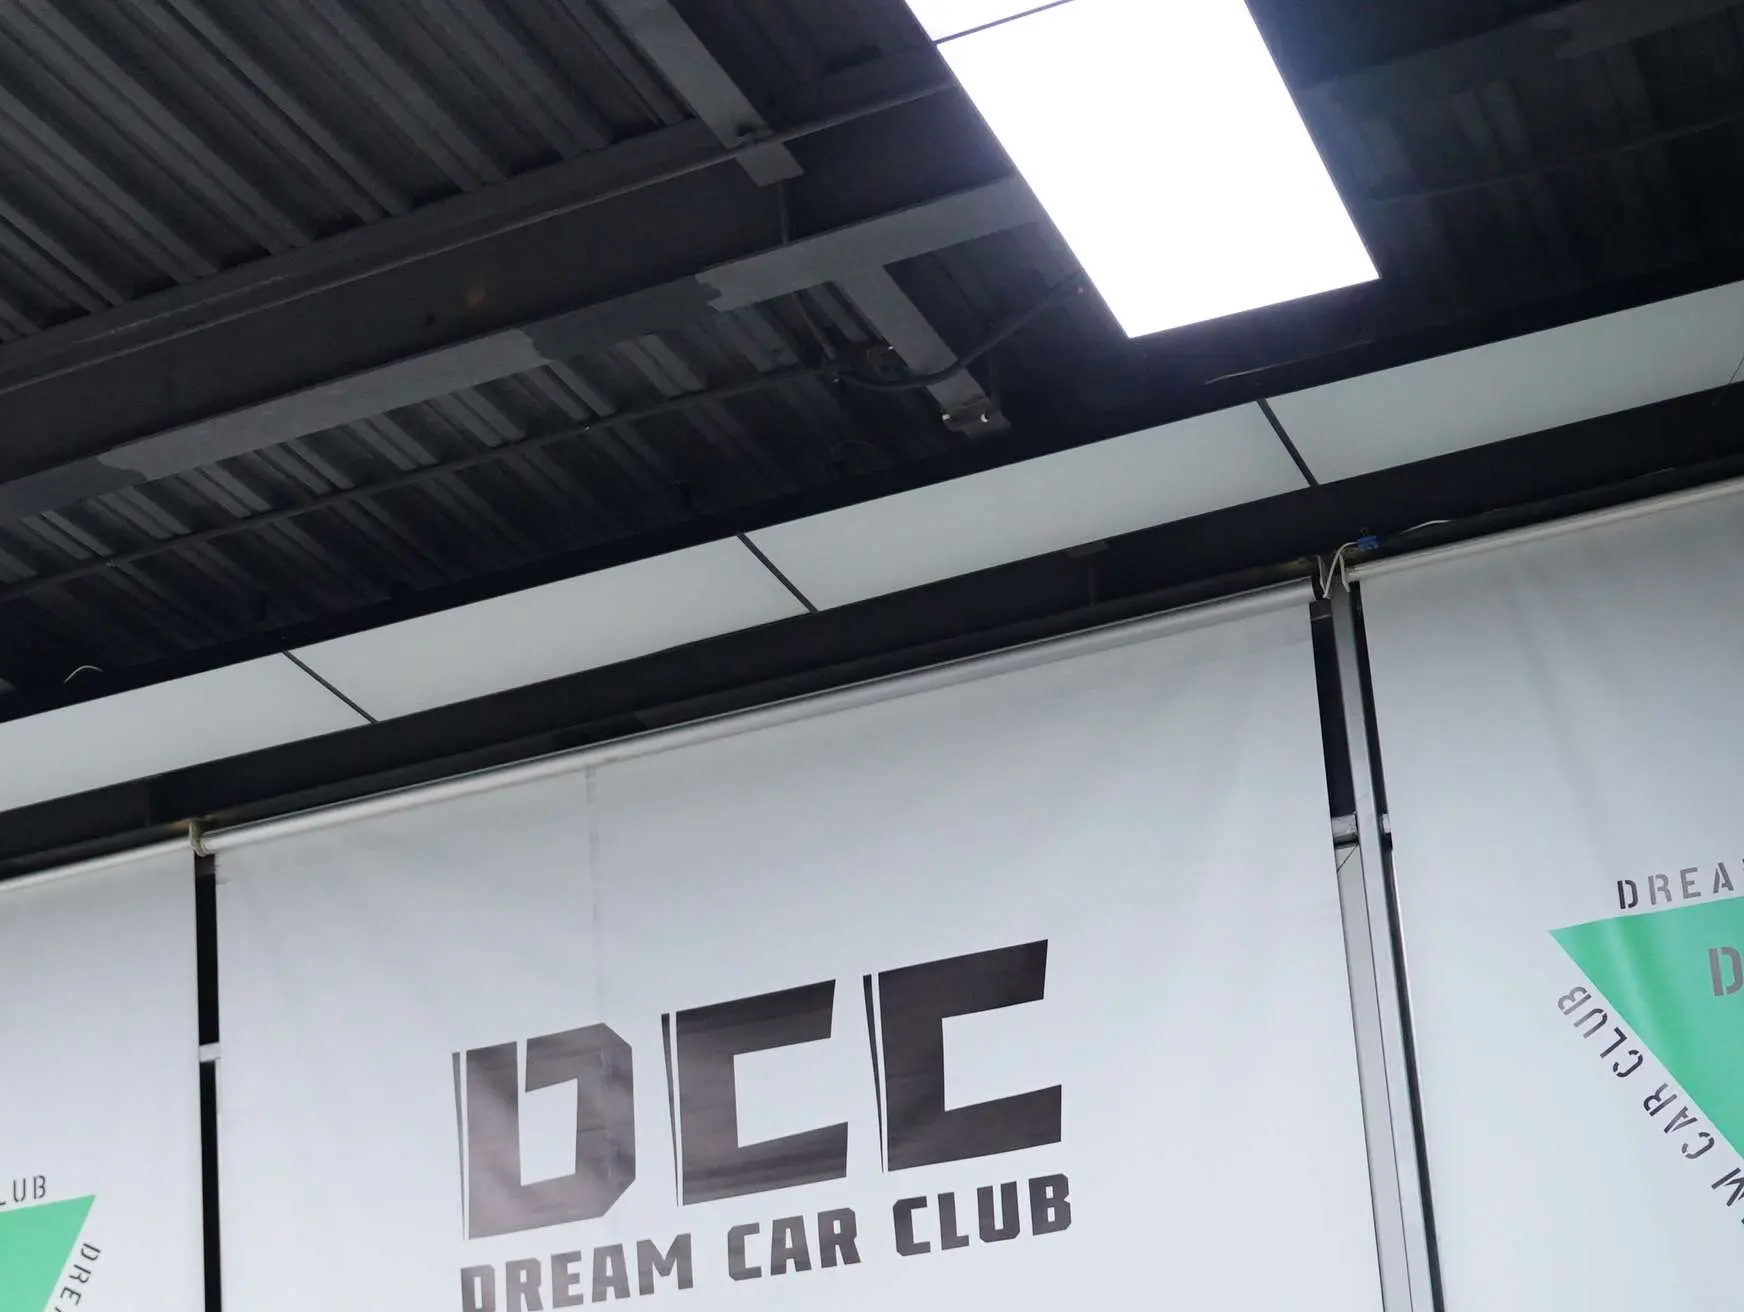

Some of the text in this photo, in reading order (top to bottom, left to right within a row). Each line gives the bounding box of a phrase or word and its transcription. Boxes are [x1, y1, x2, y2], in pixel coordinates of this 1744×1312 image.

[1616, 856, 1744, 909] DREA
[1557, 986, 1644, 1078] CLUB
[452, 938, 1062, 1241] DCC
[1643, 1083, 1715, 1159] CAR
[727, 1207, 861, 1281] CAR
[892, 1173, 1072, 1257] CLUB
